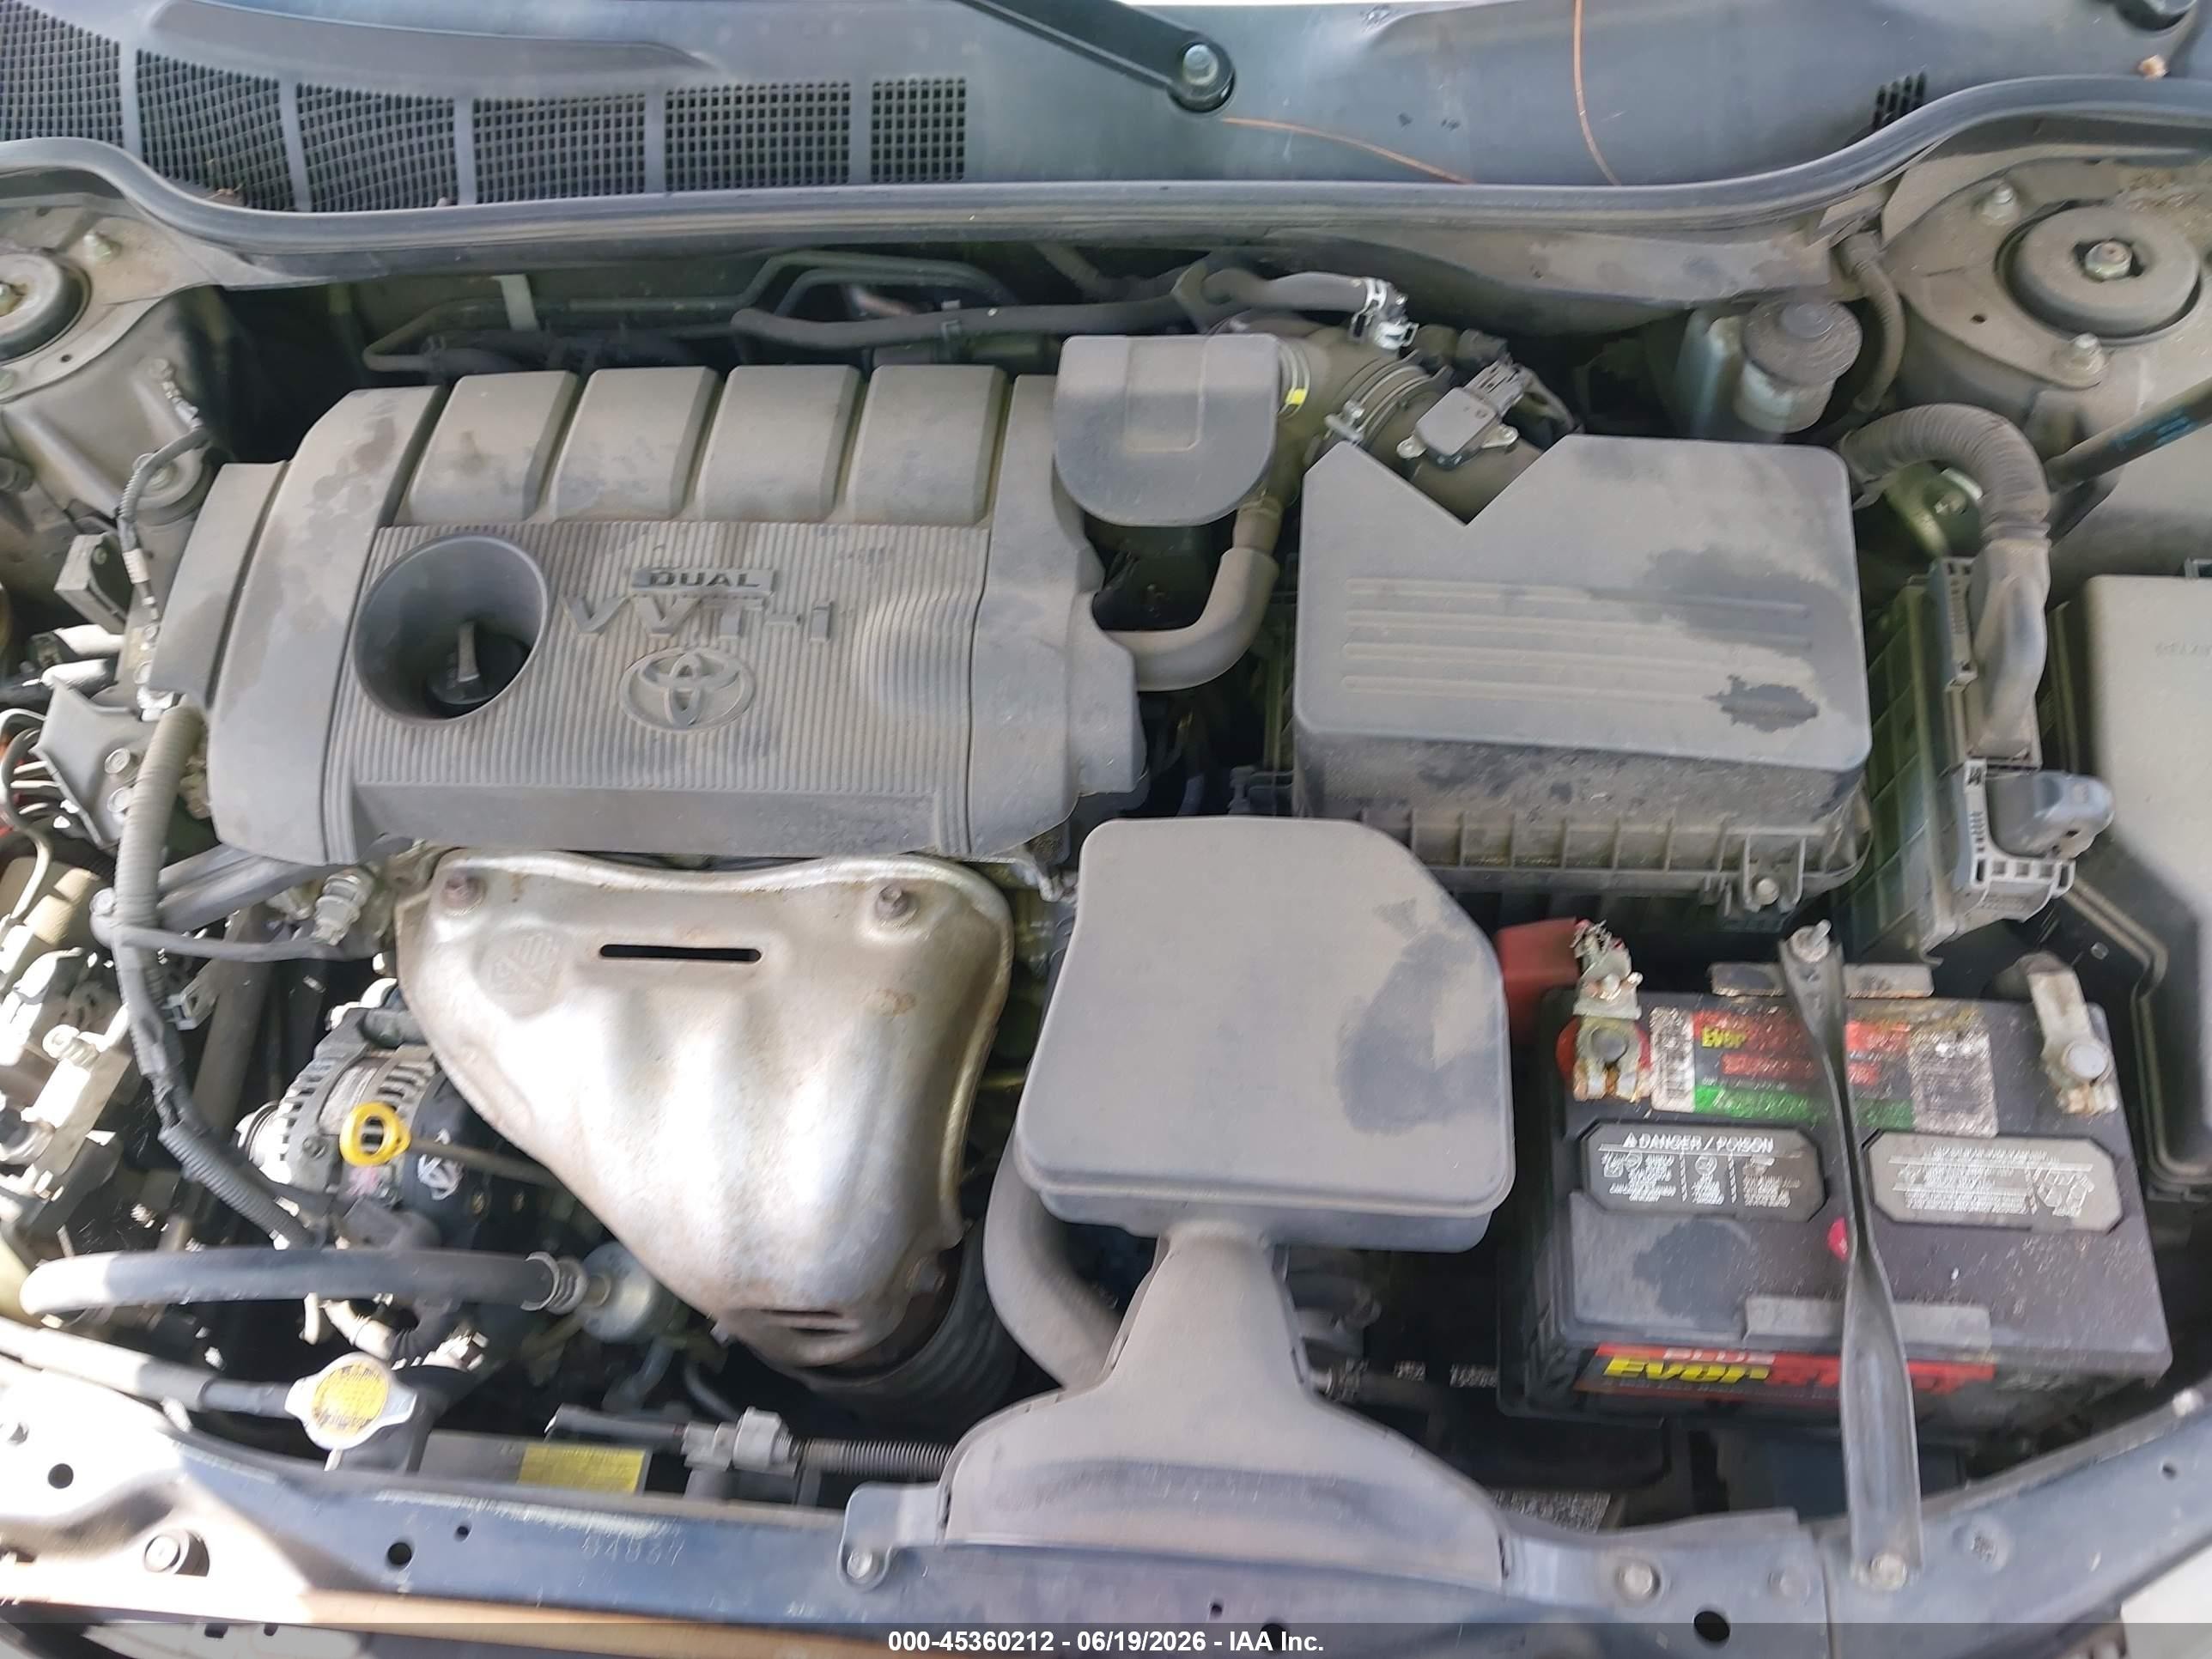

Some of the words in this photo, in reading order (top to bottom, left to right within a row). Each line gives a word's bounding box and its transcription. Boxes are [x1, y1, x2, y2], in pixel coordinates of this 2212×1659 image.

[647, 569, 761, 588] DUAL
[562, 595, 834, 644] VVT-i
[1638, 1133, 1703, 1151] DANGER
[1716, 1136, 1775, 1154] POISON
